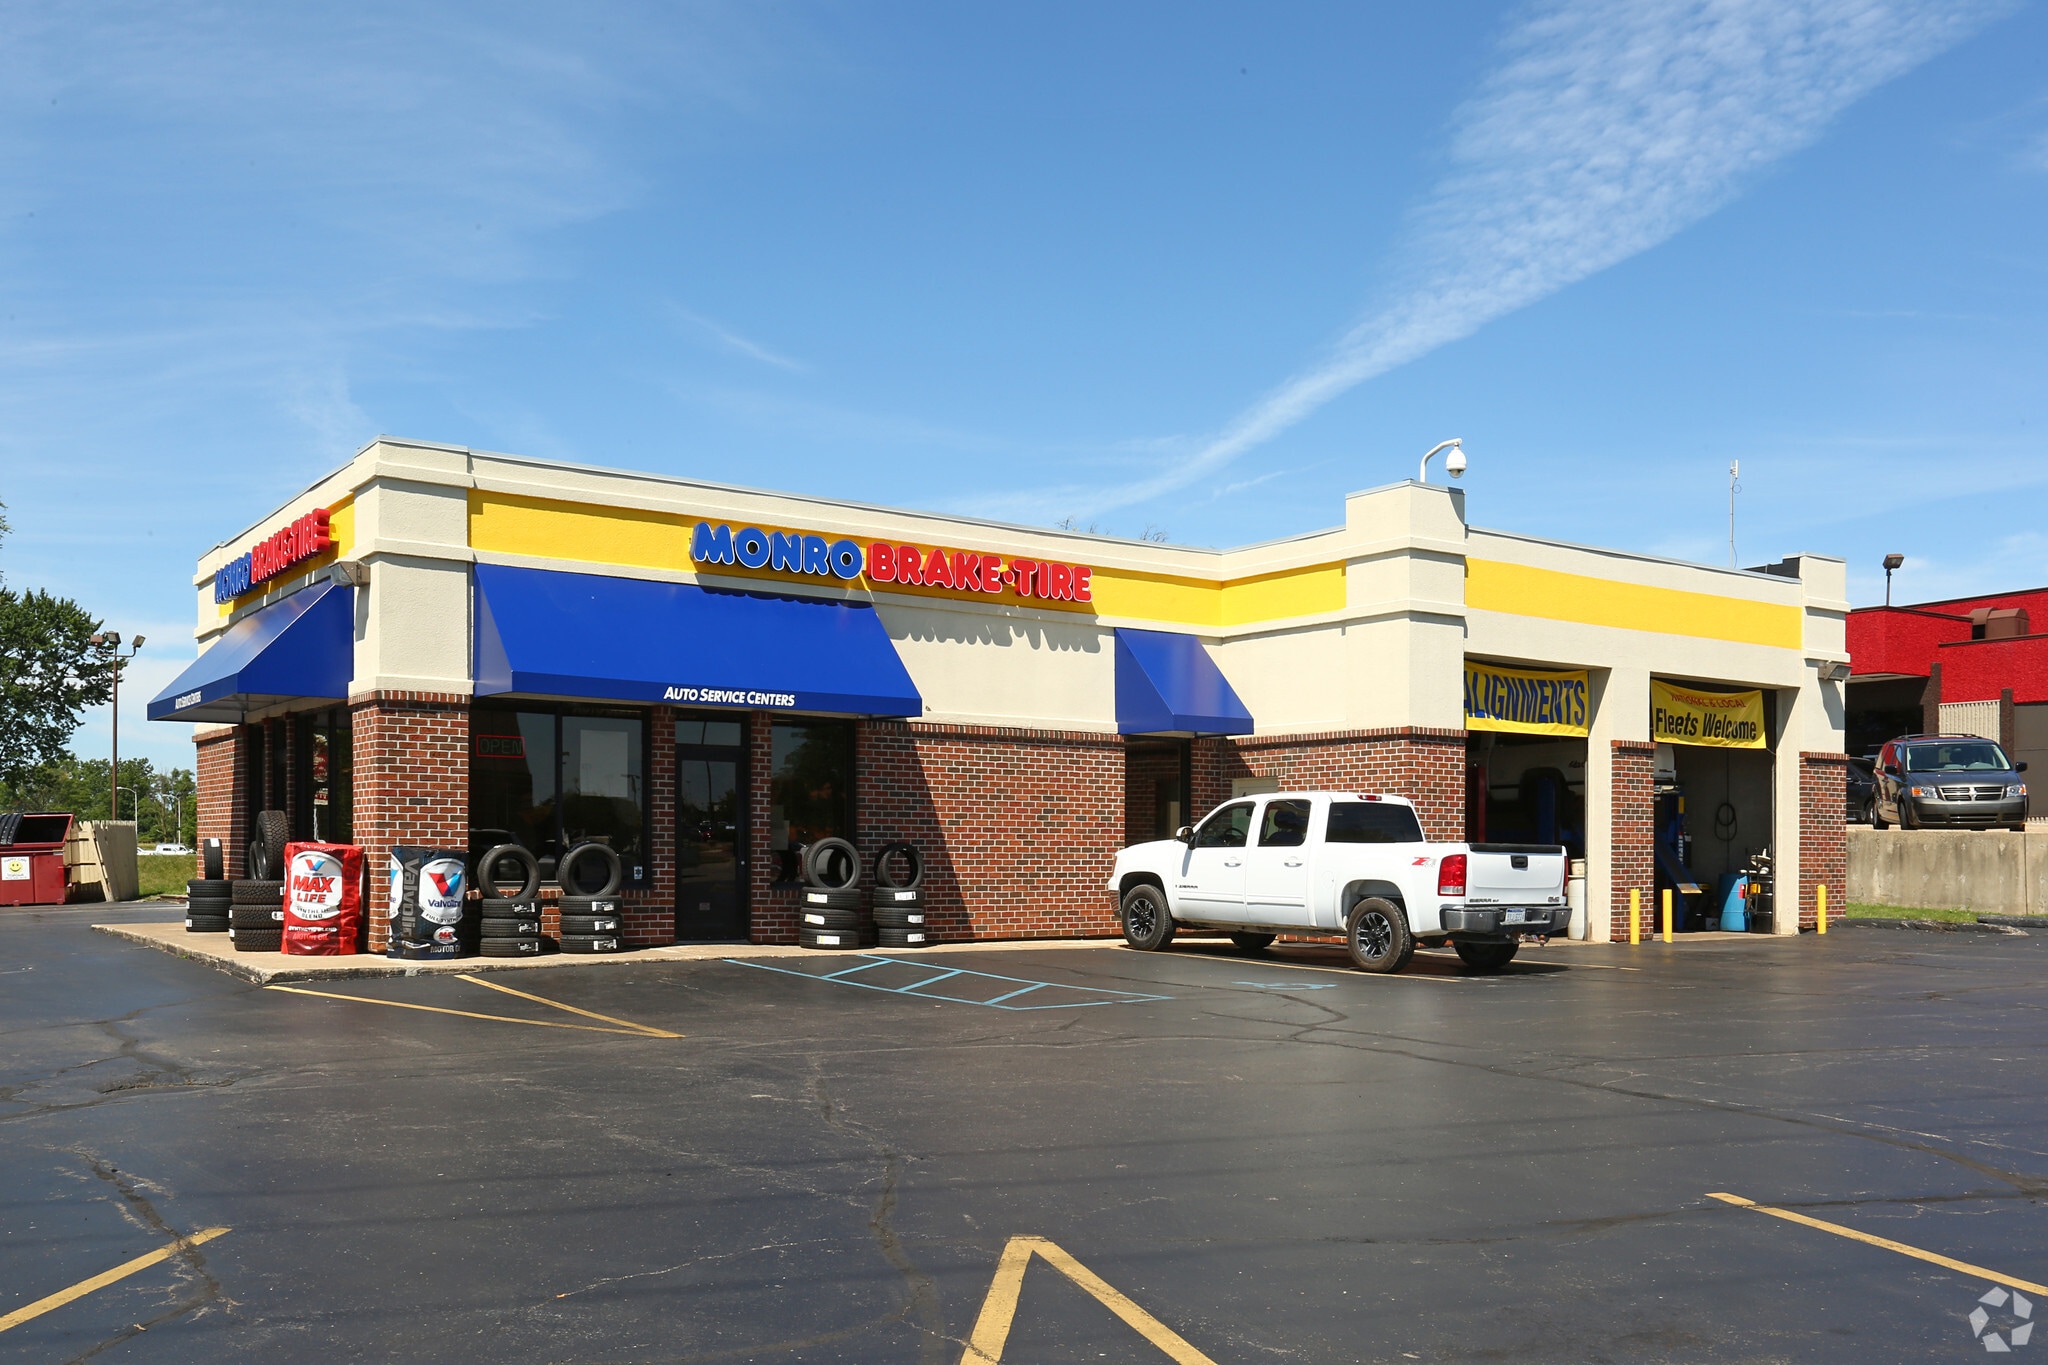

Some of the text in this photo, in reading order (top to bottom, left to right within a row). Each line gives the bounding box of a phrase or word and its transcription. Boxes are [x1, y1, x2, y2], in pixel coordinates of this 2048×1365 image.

[691, 521, 864, 580] MONRO
[215, 552, 252, 604] MONRO
[664, 686, 795, 706] AUTO SERVICE CENTERS
[1464, 670, 1585, 726] ALIGNMENTS
[1671, 693, 1747, 708] NATIONAL & LOCAL
[1655, 707, 1757, 740] Fleets Welcome
[480, 738, 522, 755] OPEN
[293, 875, 336, 893] MAX
[297, 893, 327, 903] LIFE
[426, 913, 439, 921] FULL
[430, 945, 454, 954] MOTOR
